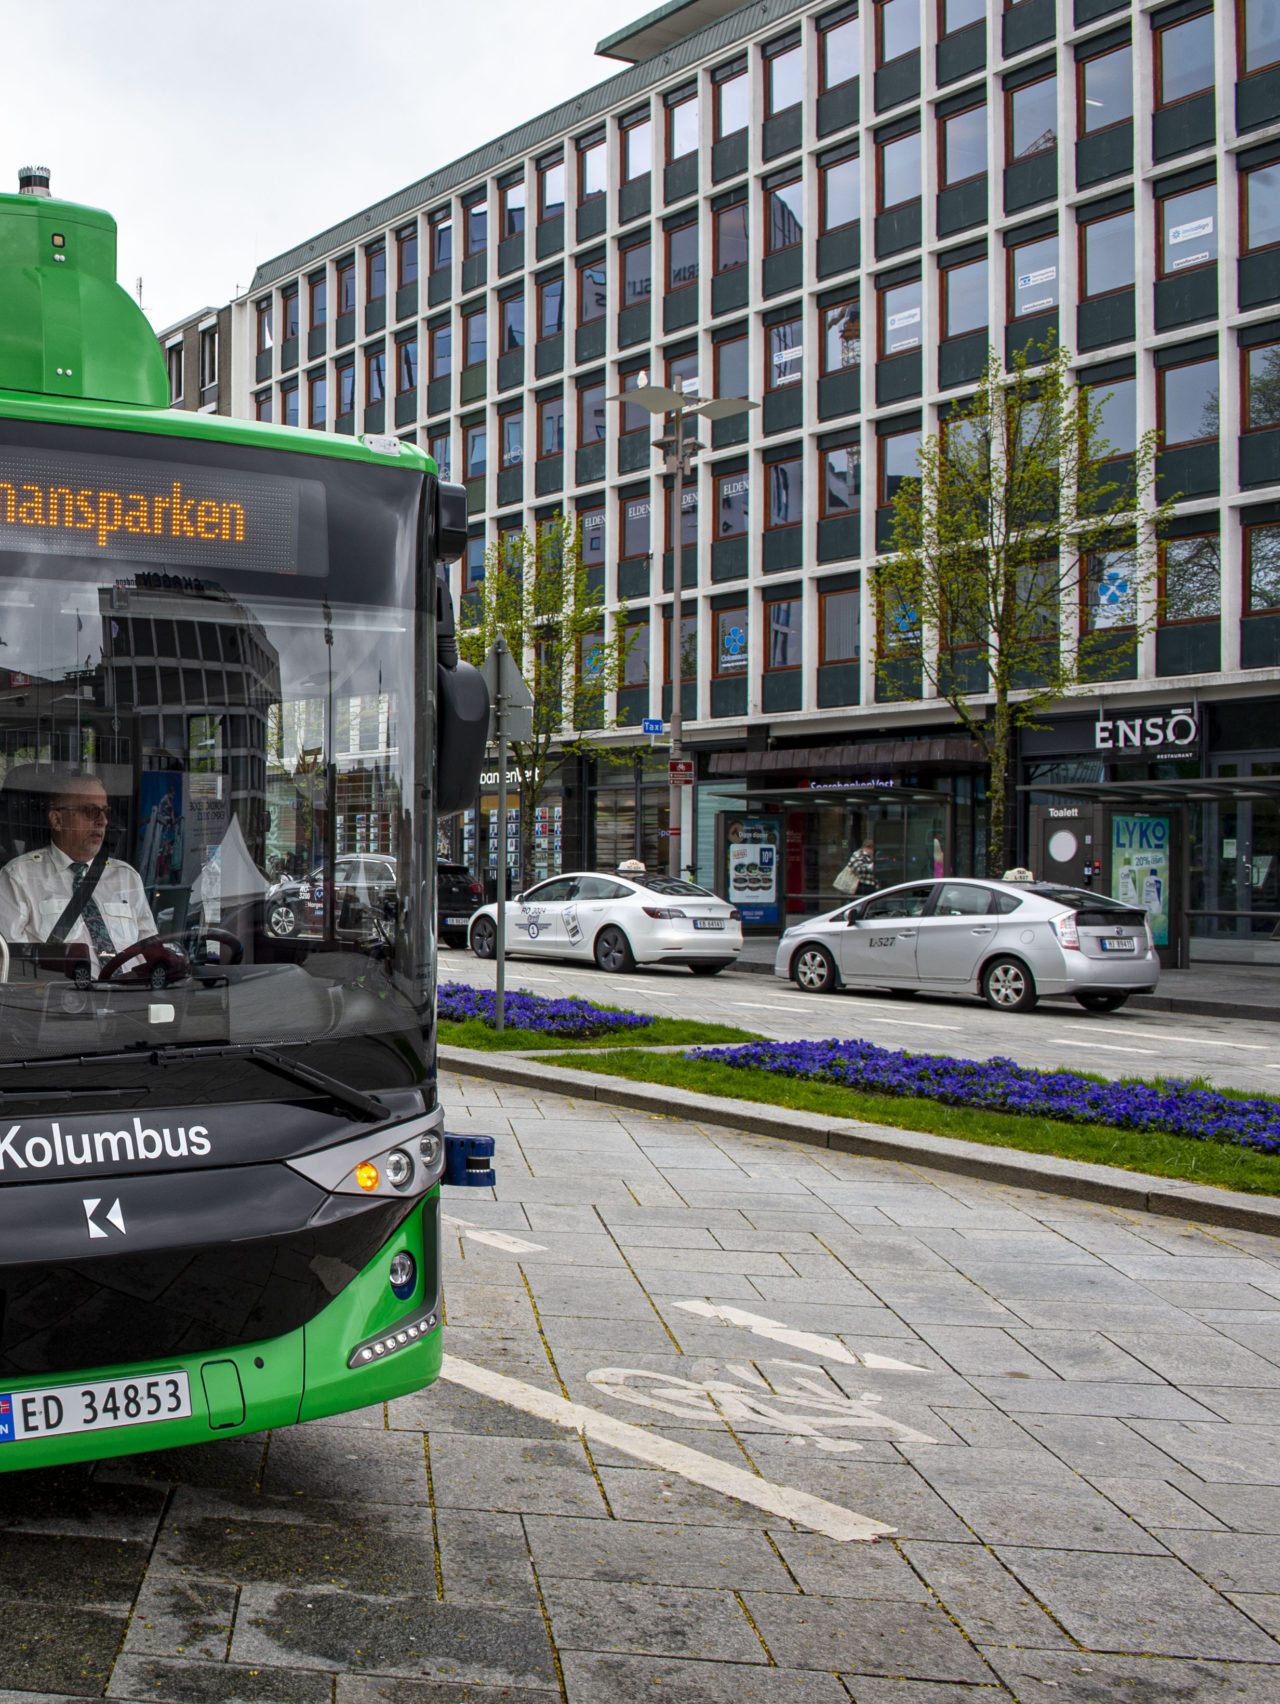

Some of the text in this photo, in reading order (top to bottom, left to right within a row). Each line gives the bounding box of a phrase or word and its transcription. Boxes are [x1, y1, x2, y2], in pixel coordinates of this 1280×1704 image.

[644, 722, 662, 731] Taxi
[1049, 808, 1079, 817] Toalett
[1115, 821, 1166, 849] LYKO
[869, 937, 896, 947] L-527
[22, 1378, 183, 1433] ED 34853
